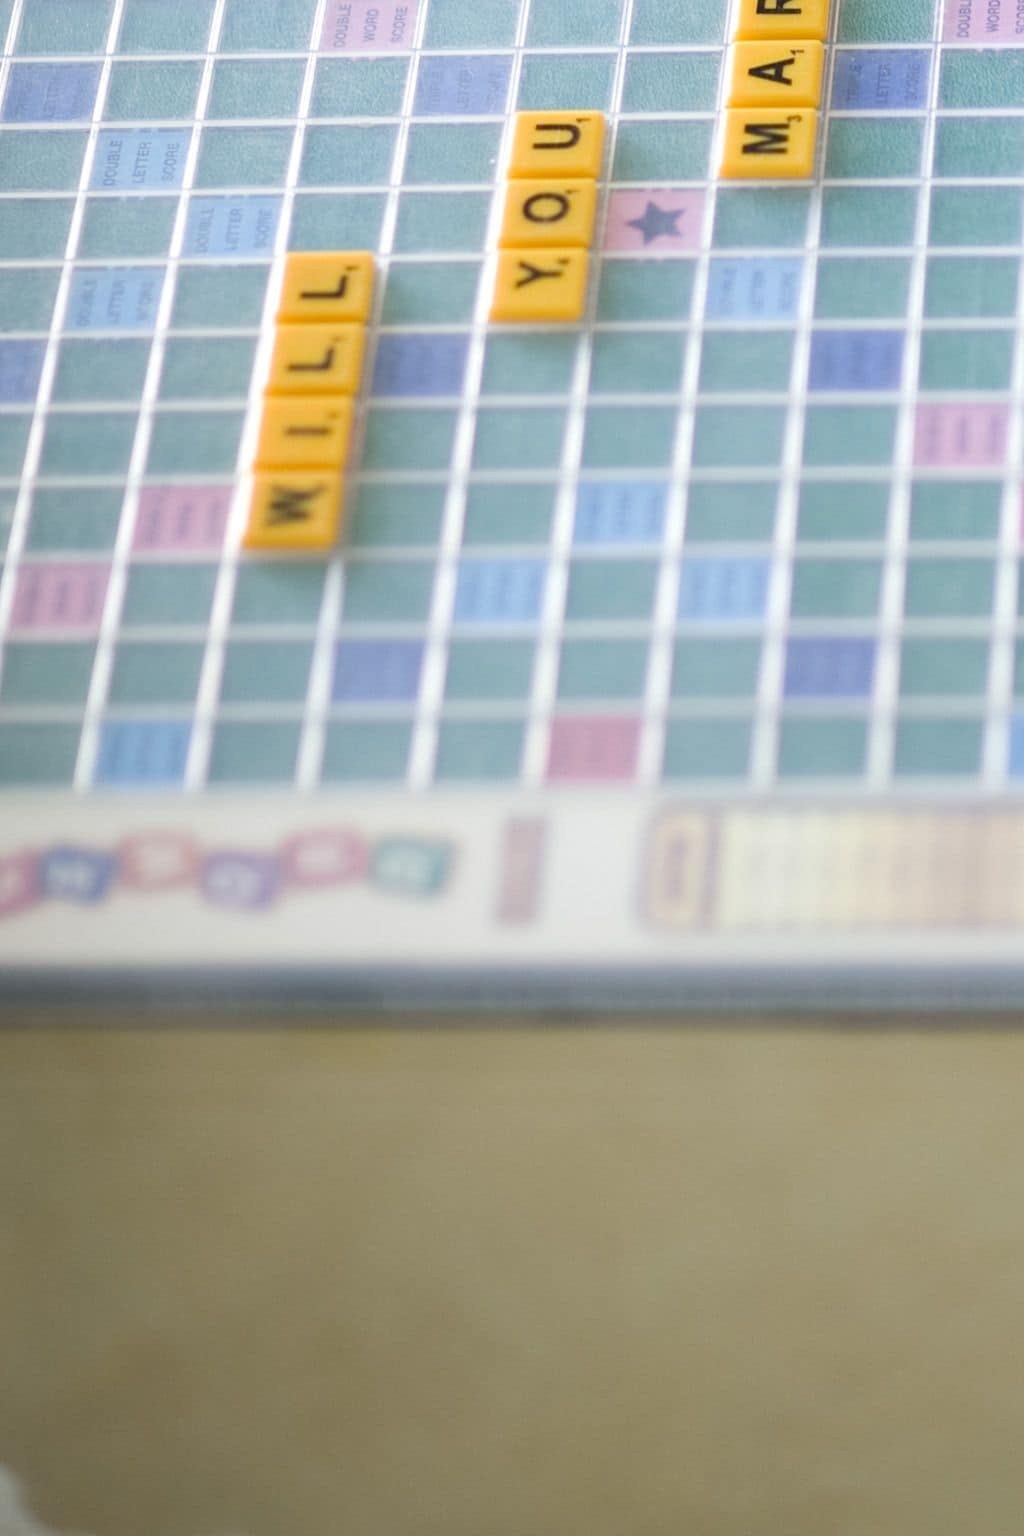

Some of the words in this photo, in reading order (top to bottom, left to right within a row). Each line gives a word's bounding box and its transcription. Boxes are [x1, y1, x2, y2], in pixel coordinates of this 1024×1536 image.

[333, 3, 352, 48] DOUBLE
[361, 8, 378, 42] WORD
[390, 6, 408, 43] SCORE
[986, 0, 1001, 33] WORD
[103, 140, 123, 186] DOUBLE
[132, 141, 153, 184] LETTER
[162, 143, 180, 182] SCORE
[514, 124, 581, 290] YOU
[225, 207, 243, 252] LETTER
[264, 274, 348, 527] WILL
